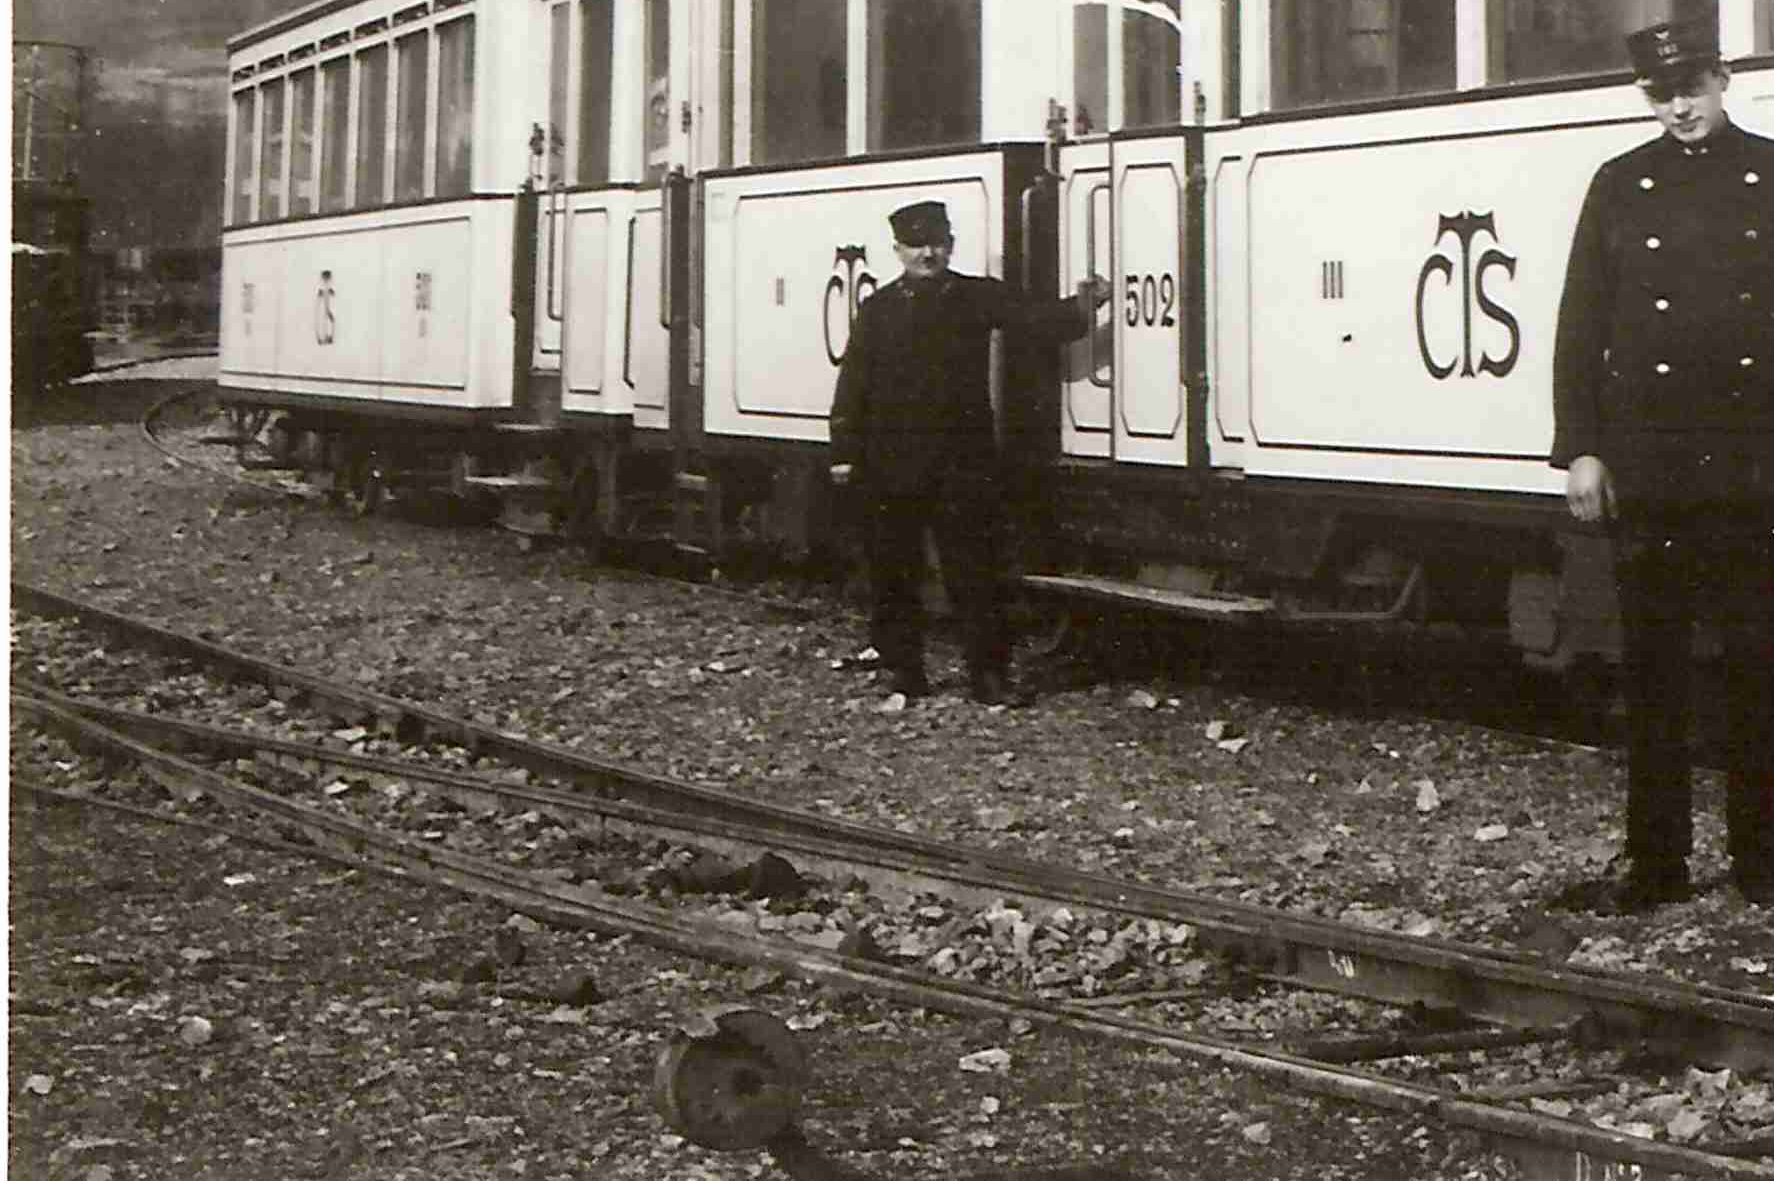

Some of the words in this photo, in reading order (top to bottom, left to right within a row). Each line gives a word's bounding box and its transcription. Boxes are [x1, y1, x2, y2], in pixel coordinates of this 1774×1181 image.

[823, 244, 878, 367] CT
[1125, 273, 1176, 328] 502
[1415, 210, 1521, 381] CTS
